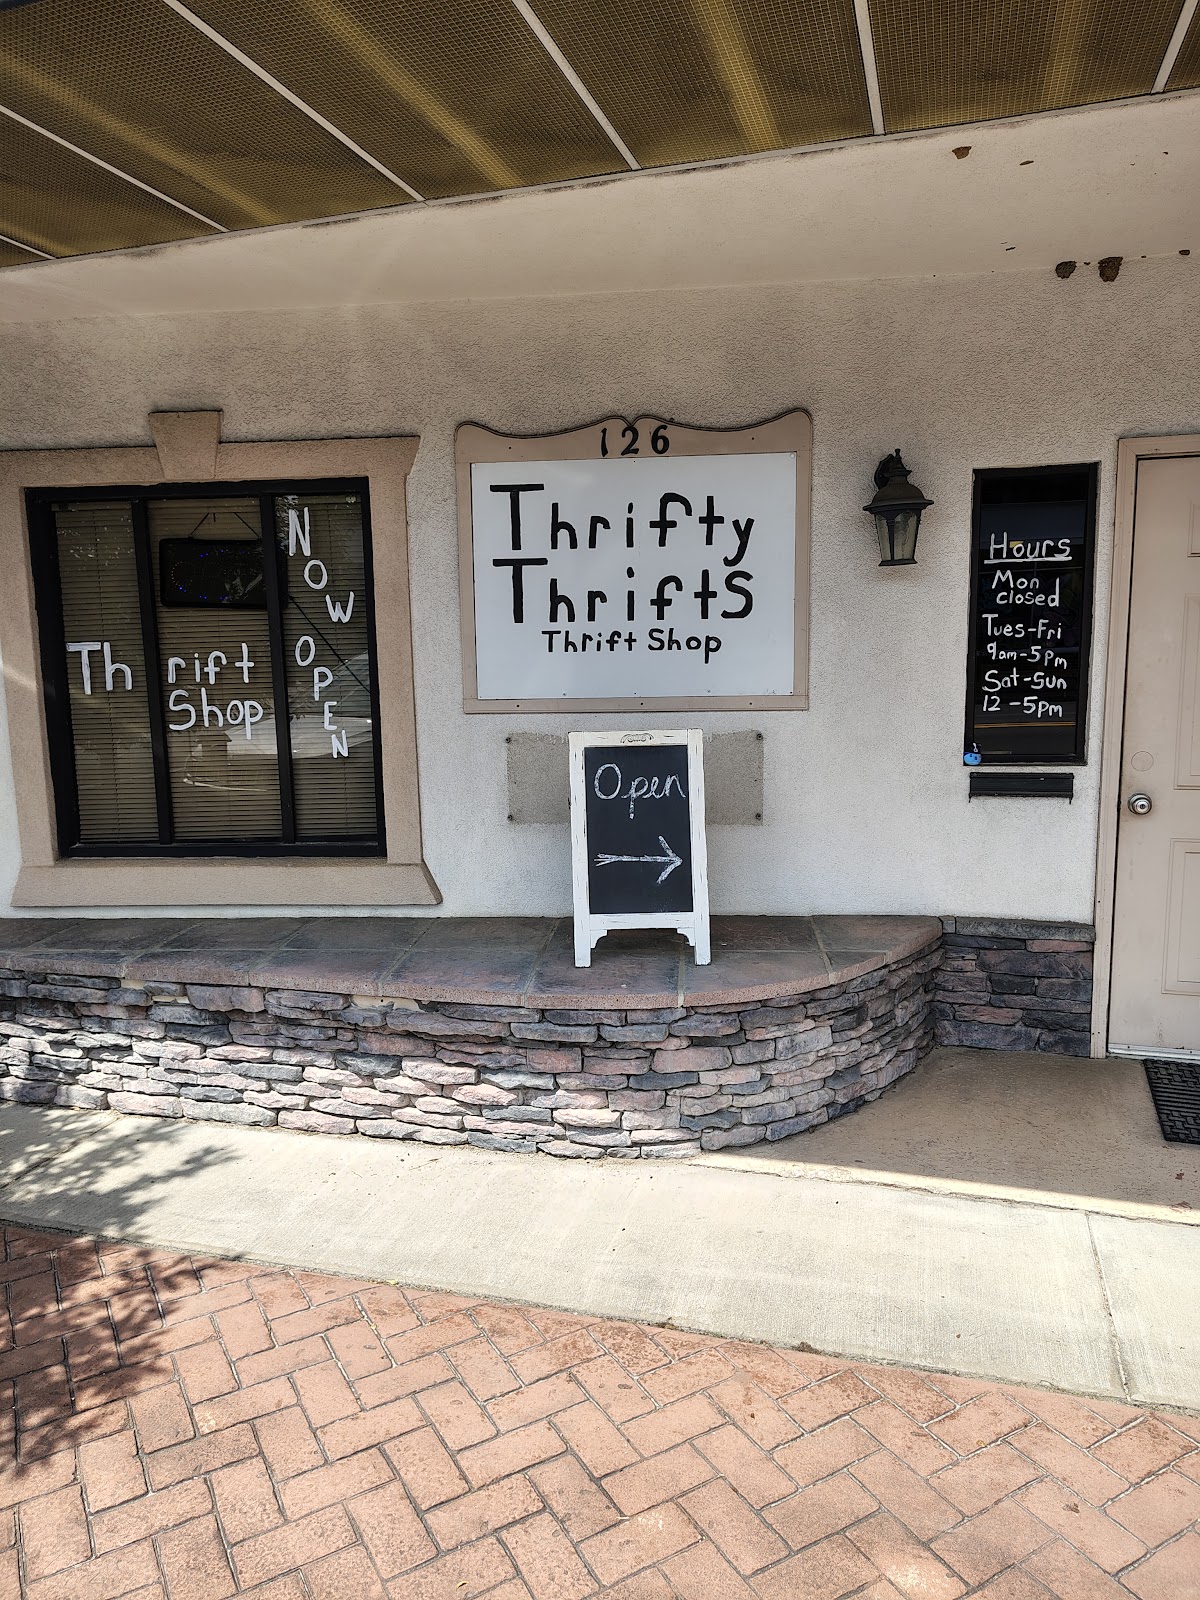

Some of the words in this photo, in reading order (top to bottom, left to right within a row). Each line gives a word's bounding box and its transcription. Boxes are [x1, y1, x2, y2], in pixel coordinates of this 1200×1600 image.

[600, 424, 671, 457] 126
[489, 483, 755, 567] Thrifty
[990, 531, 1071, 559] Hours
[991, 569, 1040, 589] Mon
[996, 577, 1060, 607] closed
[541, 630, 637, 653] Thrift
[647, 627, 722, 664] Shop
[168, 687, 264, 740] Shop
[593, 762, 687, 820] Open
